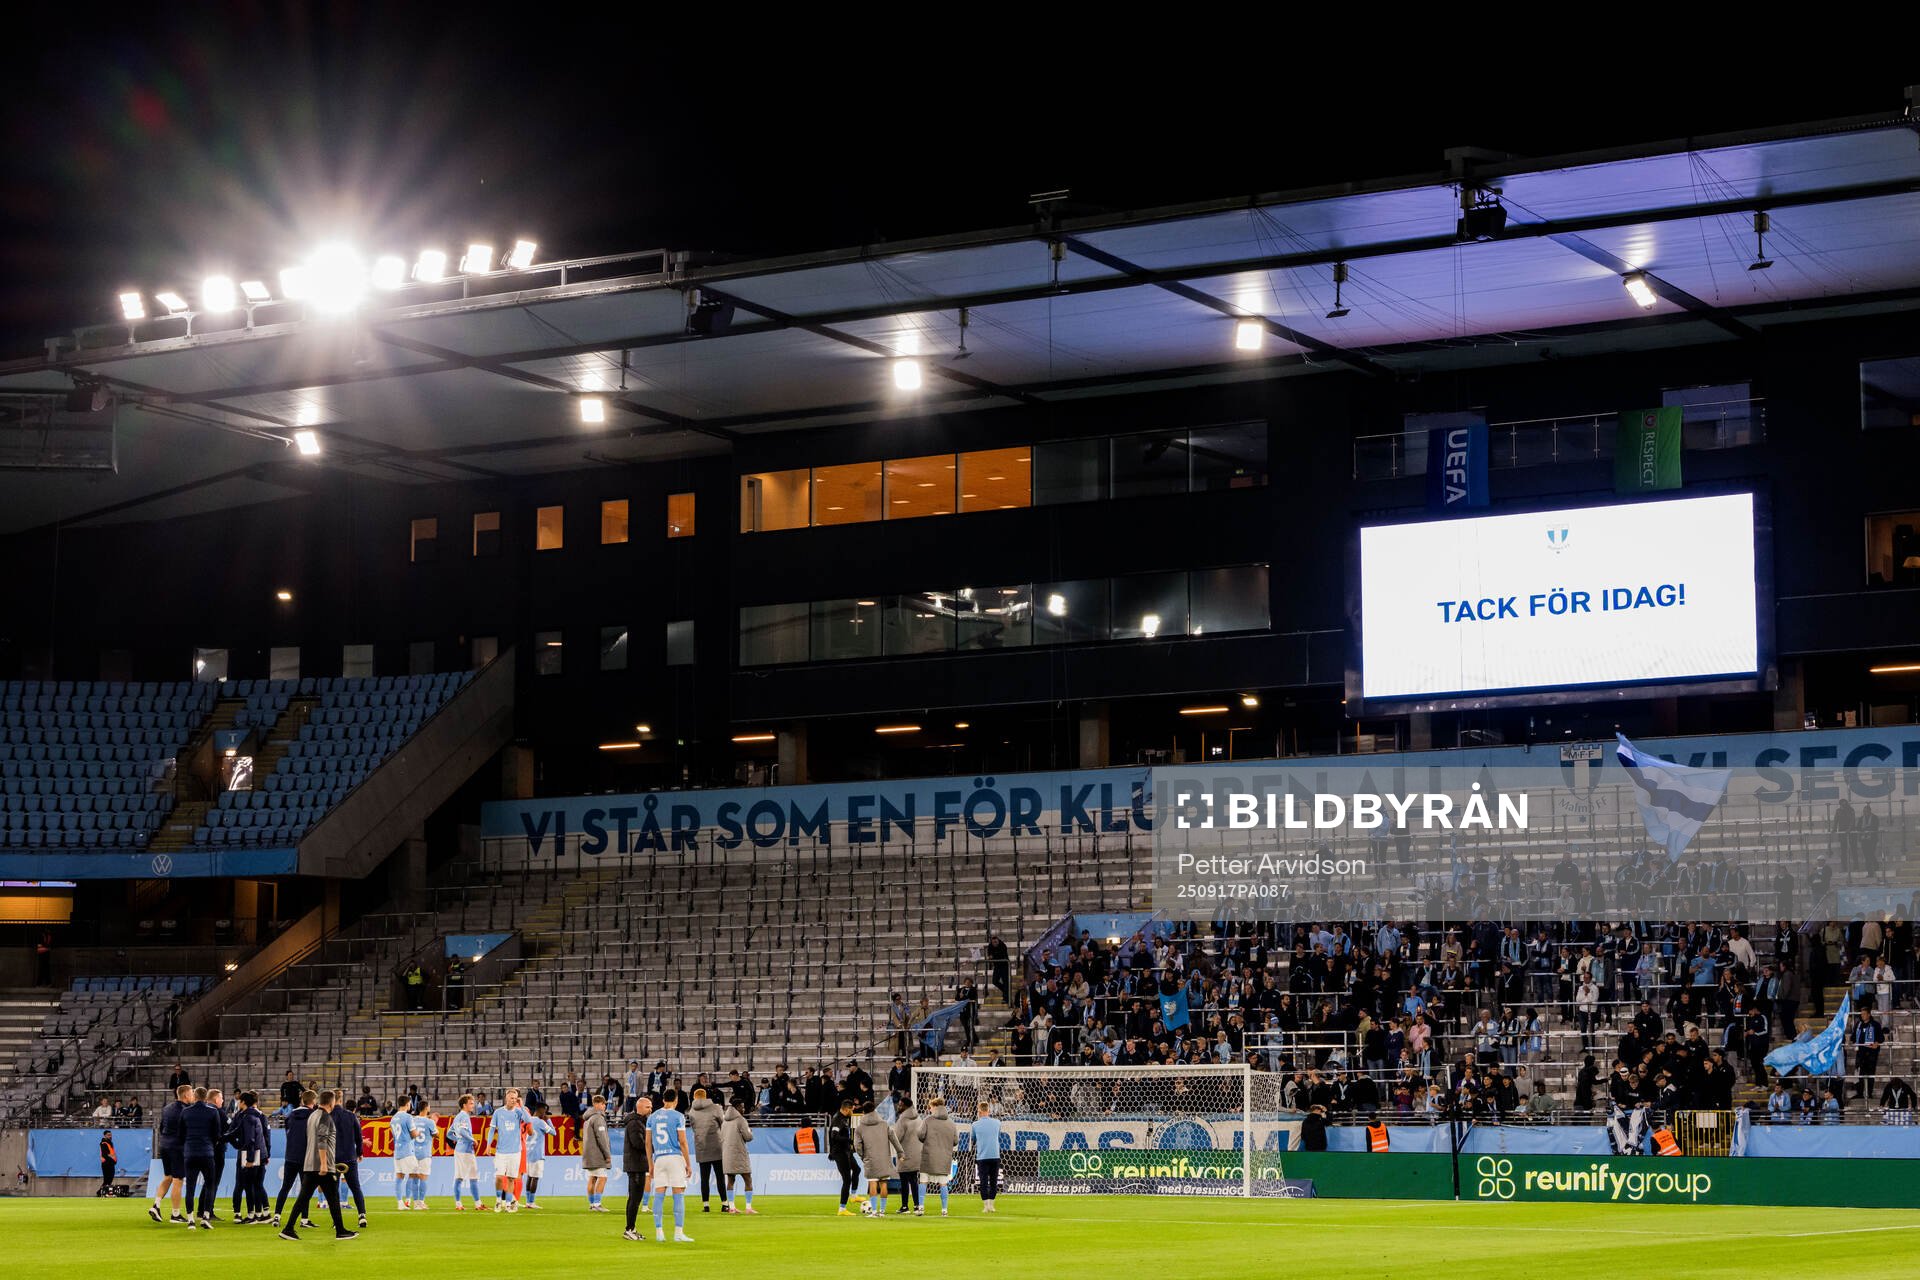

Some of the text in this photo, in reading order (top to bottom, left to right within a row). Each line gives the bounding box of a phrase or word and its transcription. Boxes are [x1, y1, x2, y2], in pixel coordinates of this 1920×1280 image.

[1446, 429, 1468, 504] UEFA
[1643, 432, 1656, 485] RESPECT
[1437, 584, 1686, 623] TACK FÖR IDAG!
[520, 811, 565, 857] VI
[581, 794, 700, 855] STÅR
[716, 796, 831, 849] SOM
[848, 793, 916, 843] EN
[934, 776, 1042, 839] FÖR
[656, 1122, 669, 1145] 5
[1008, 1183, 1091, 1196] Alltid lägsta pris
[1157, 1185, 1182, 1194] med
[1525, 1163, 1711, 1201] reunifygroup
